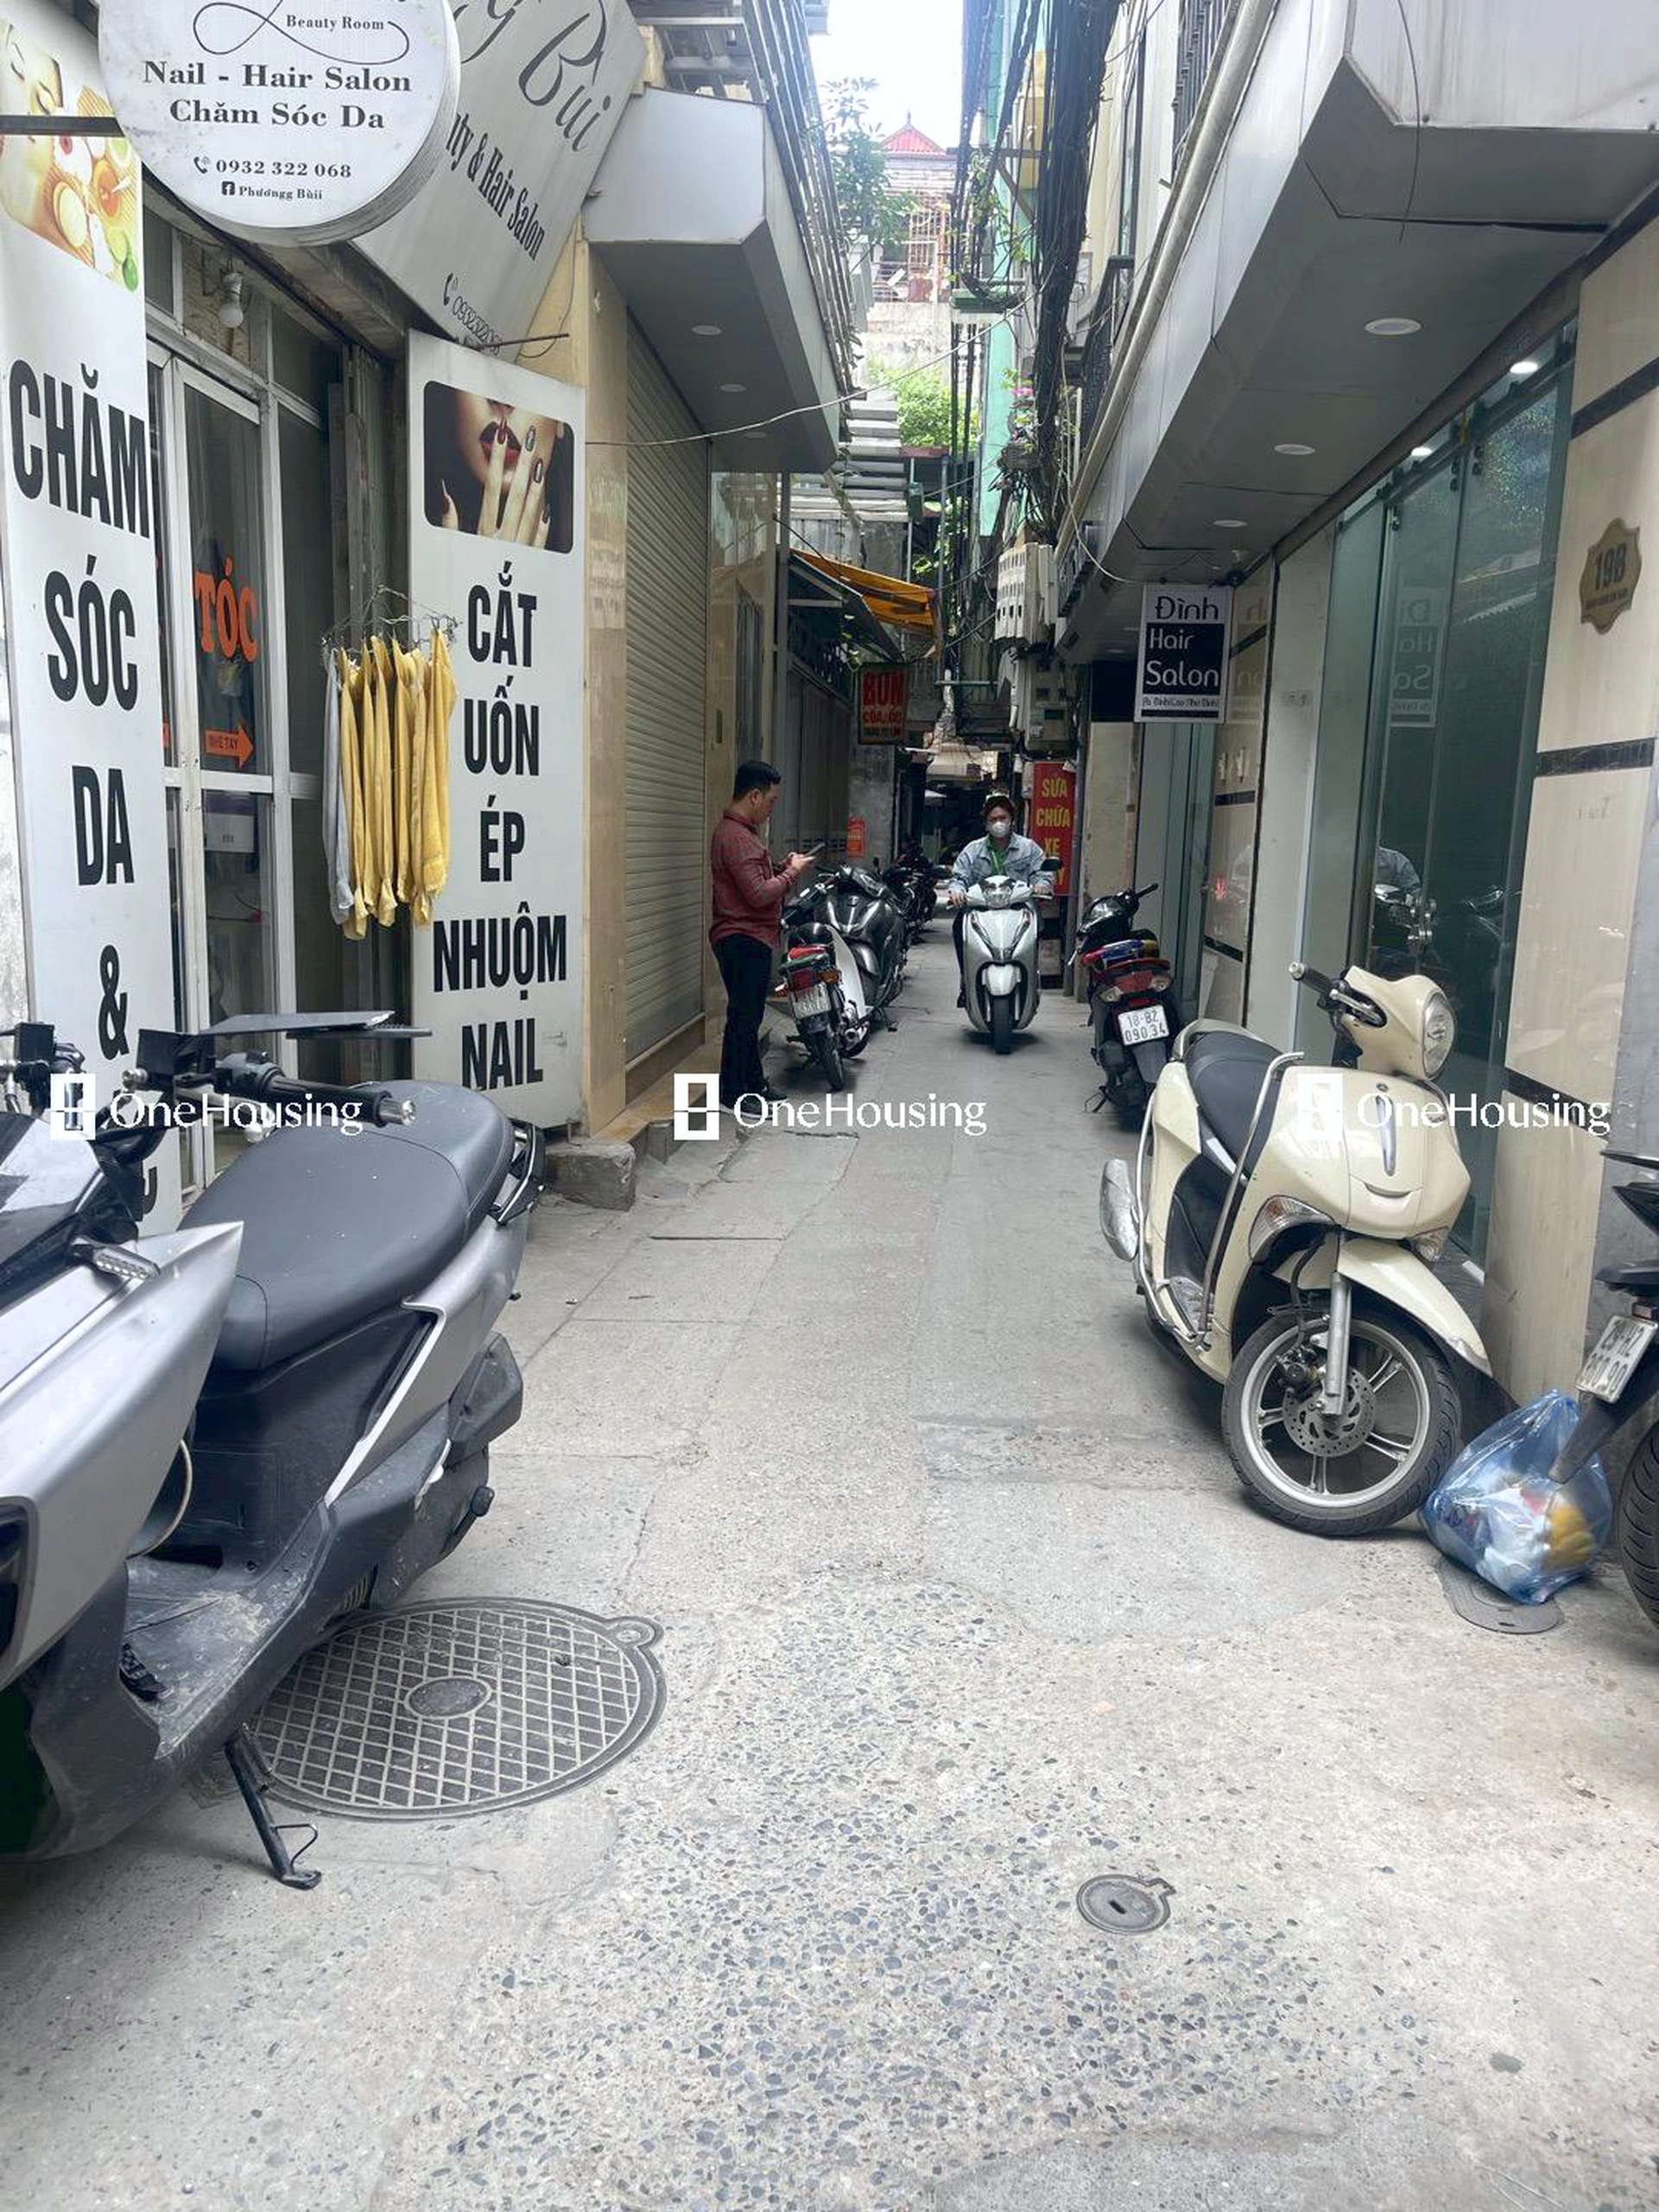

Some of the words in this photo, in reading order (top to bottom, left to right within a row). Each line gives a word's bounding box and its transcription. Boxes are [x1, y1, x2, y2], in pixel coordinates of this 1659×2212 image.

[286, 15, 337, 31] Beauty
[342, 16, 385, 30] Room
[142, 60, 206, 85] Nail
[242, 64, 313, 89] Hair
[325, 67, 412, 92] Salon
[169, 98, 259, 124] Chăm
[271, 103, 327, 127] Sóc
[340, 105, 385, 129] Da
[216, 160, 265, 174] 0932
[271, 162, 307, 175] 322
[314, 164, 351, 178] 068
[478, 147, 516, 219] Hair
[508, 187, 547, 260] Salon
[9, 359, 149, 538] CHĂM
[44, 554, 138, 711] SÓC
[195, 555, 258, 665] TÓC
[467, 561, 537, 668] CẮT
[1149, 628, 1195, 650] Hair
[1155, 595, 1219, 620] Đình
[1145, 659, 1219, 688] Salon
[464, 675, 540, 776] UỐN
[72, 764, 134, 885] DA
[480, 795, 525, 882] ÉP
[1043, 837, 1061, 856] XE
[434, 901, 567, 1000] NHUỘM
[98, 944, 130, 1061] &
[462, 1017, 543, 1092] NAIL
